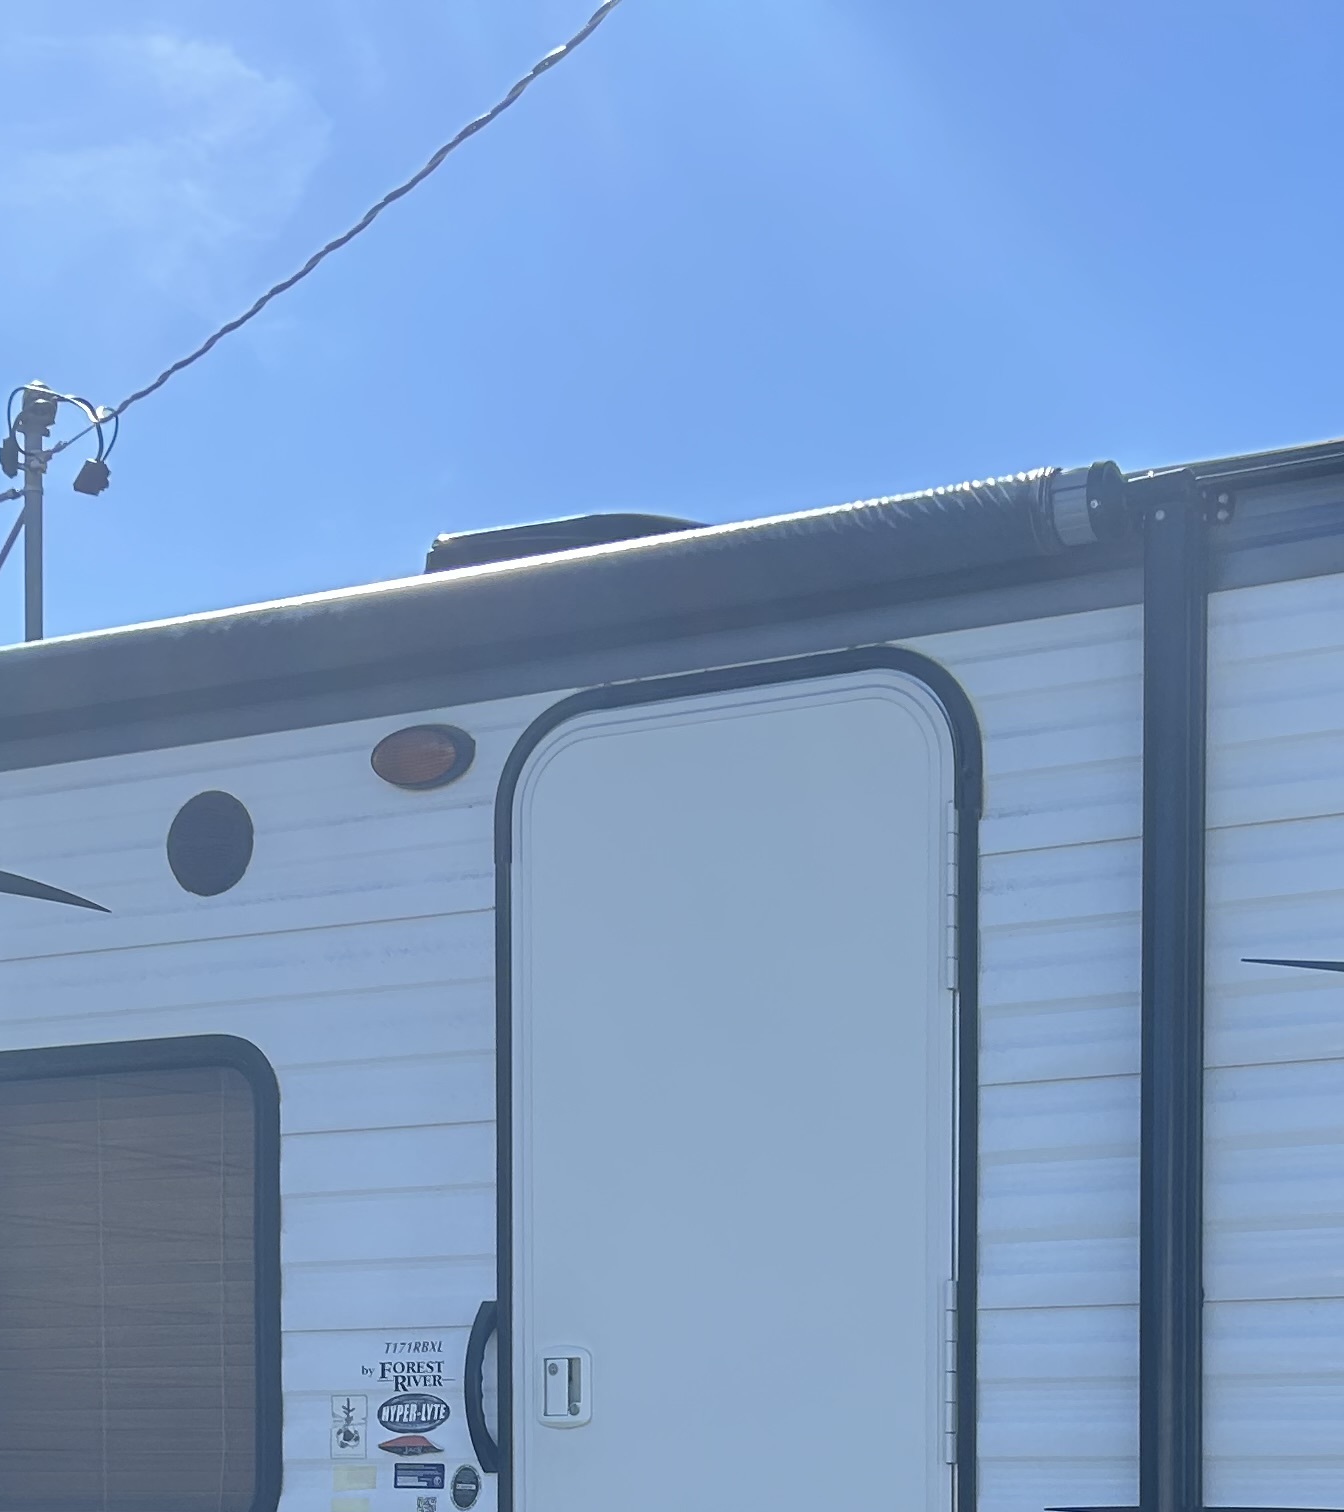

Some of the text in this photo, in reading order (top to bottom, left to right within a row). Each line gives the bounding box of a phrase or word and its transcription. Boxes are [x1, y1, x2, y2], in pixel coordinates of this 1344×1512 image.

[385, 1341, 443, 1354] T171RBXL
[361, 1360, 444, 1379] by FOREST
[393, 1375, 444, 1392] RIVER
